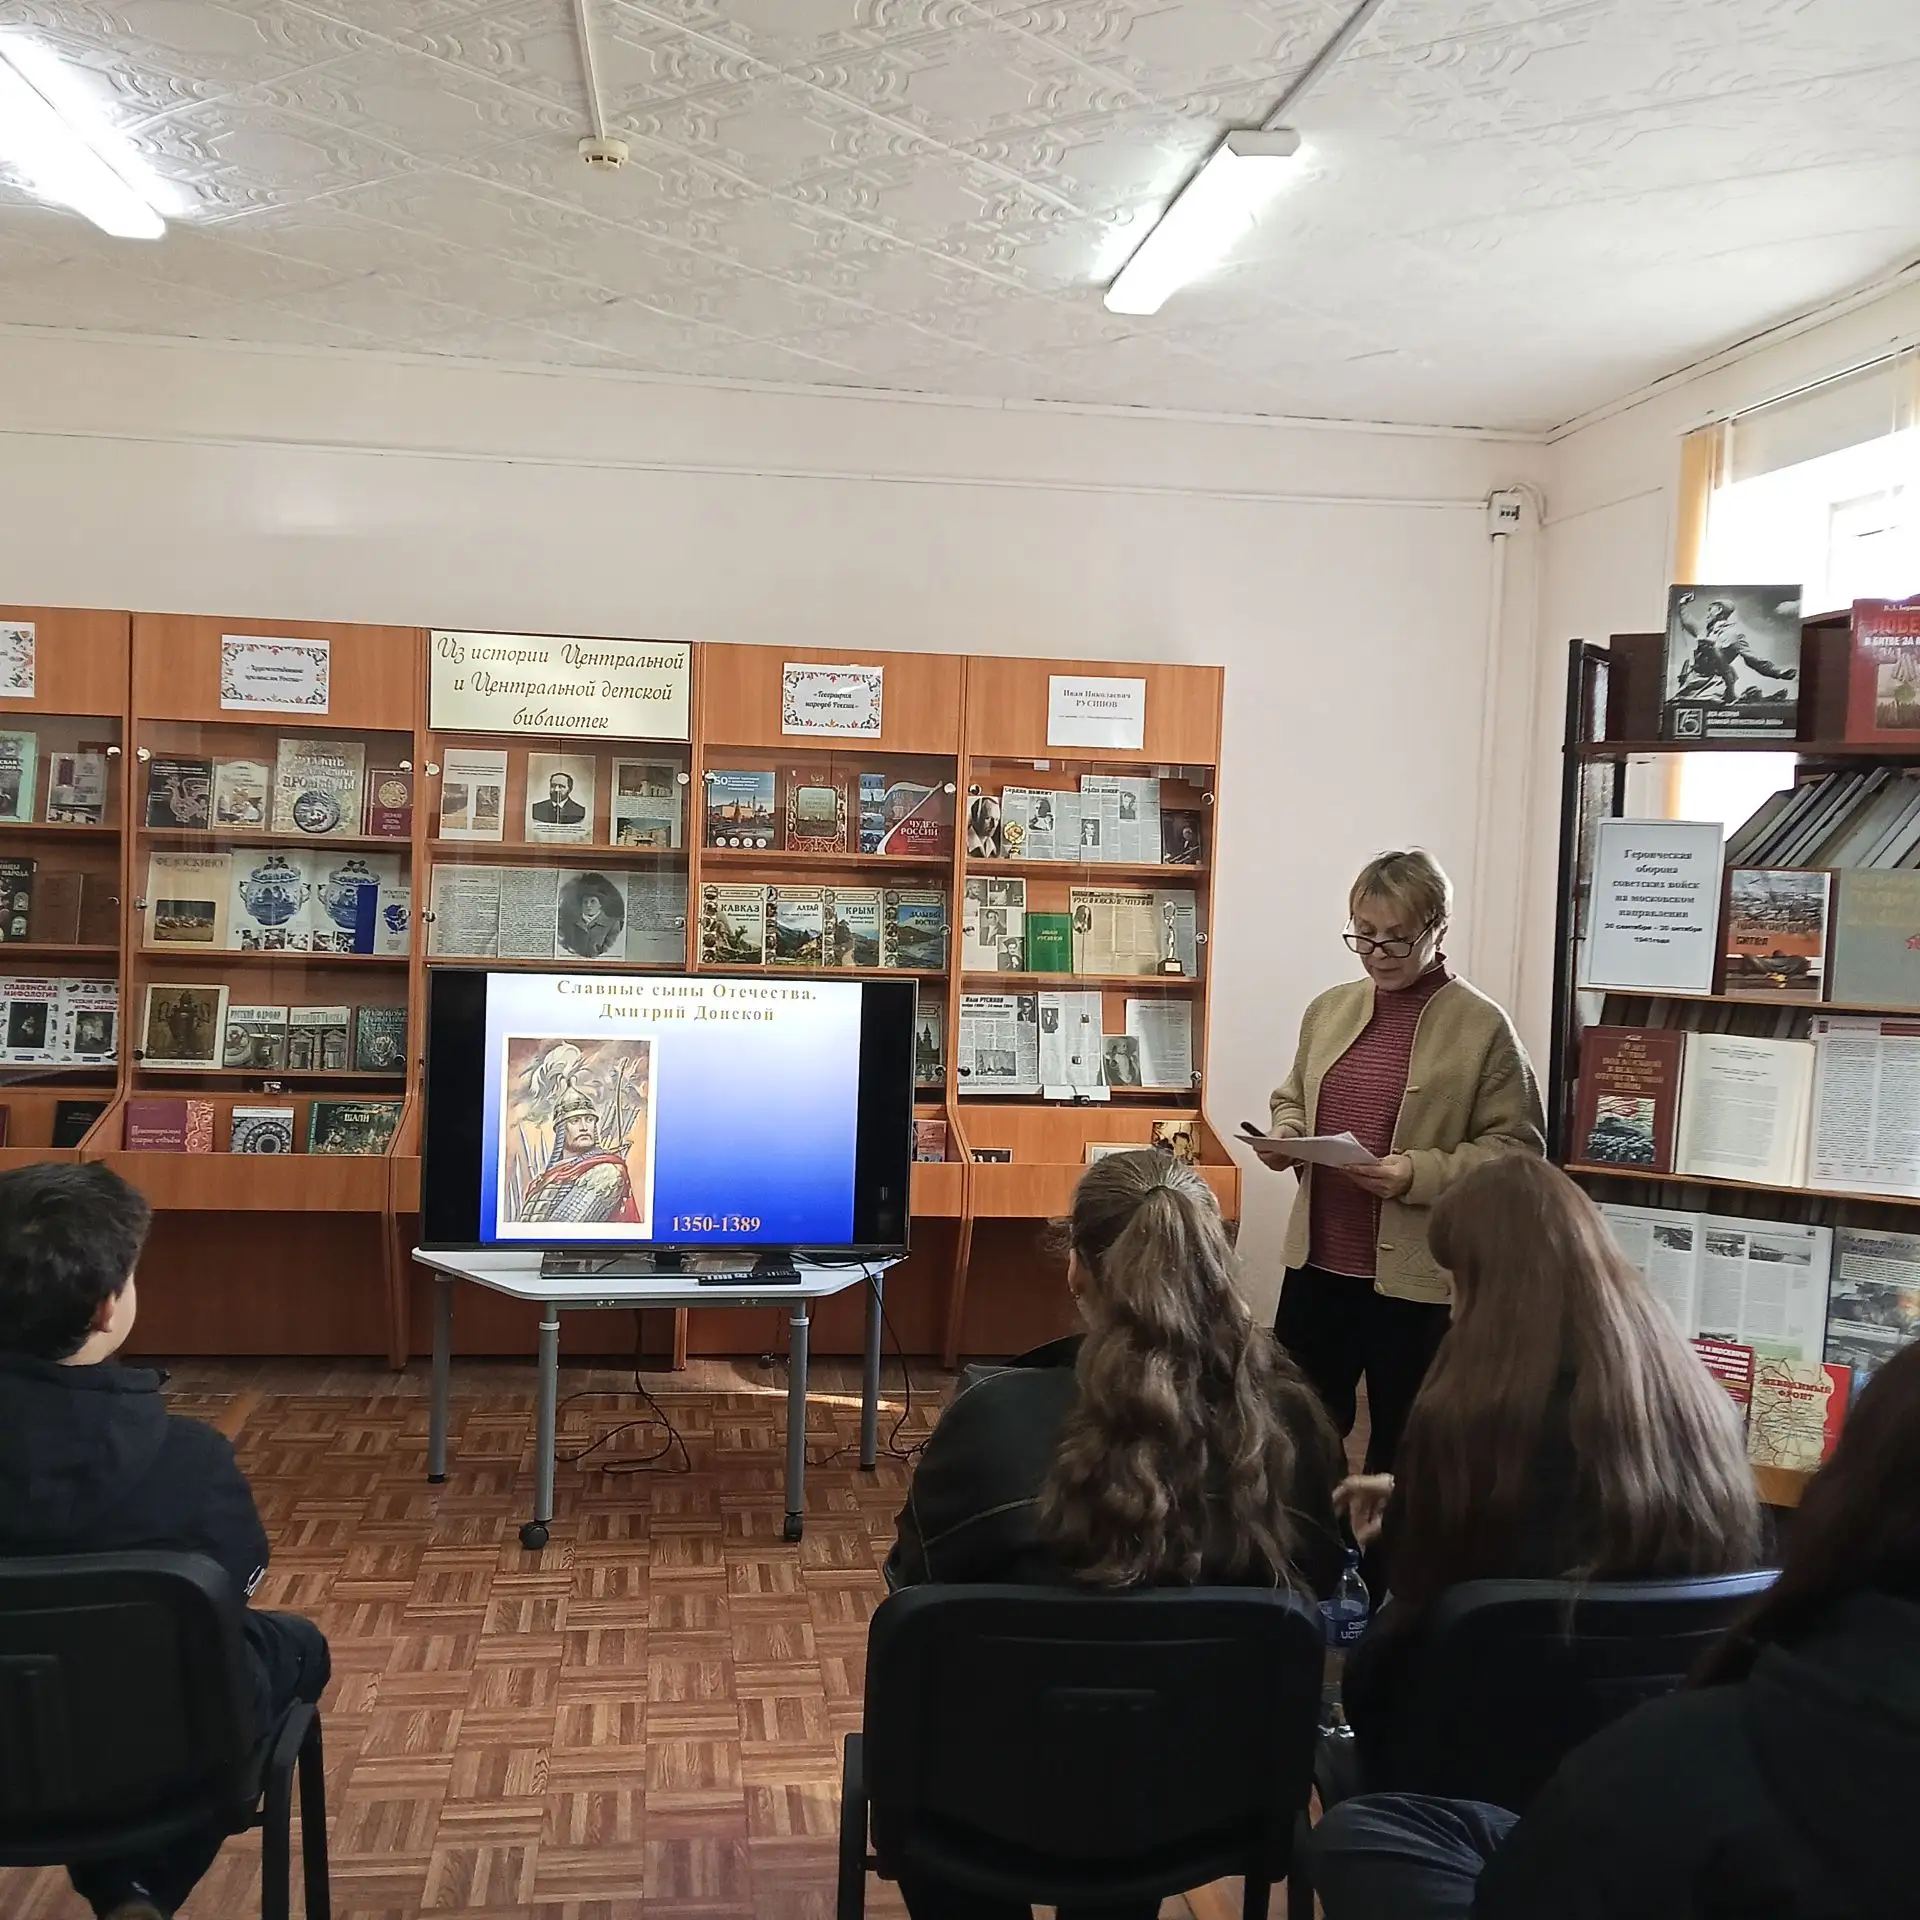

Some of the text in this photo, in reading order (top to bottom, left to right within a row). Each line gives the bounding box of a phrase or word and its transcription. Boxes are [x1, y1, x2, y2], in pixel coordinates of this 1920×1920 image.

[437, 637, 685, 670] Из истории Центральной
[454, 671, 673, 701] и Центральной детской
[513, 706, 609, 729] библиотек
[909, 820, 939, 829] ЧУДЕС
[900, 828, 938, 836] РОССИИ
[1624, 849, 1692, 860] Героическая
[1635, 864, 1678, 875] оборона
[1612, 880, 1700, 889] советских войск
[1631, 895, 1695, 903] московском
[720, 904, 760, 913] КАВКАЗ
[846, 906, 874, 915] КРЫМ
[1618, 909, 1688, 918] направлении
[4, 990, 57, 998] МИФОЛОГИЯ
[557, 980, 817, 1000] Славные сыны Отечества.
[599, 1004, 774, 1022] Дмитрий Донской
[344, 1113, 370, 1122] ШАЛИ
[672, 1216, 761, 1232] 1350-1389
